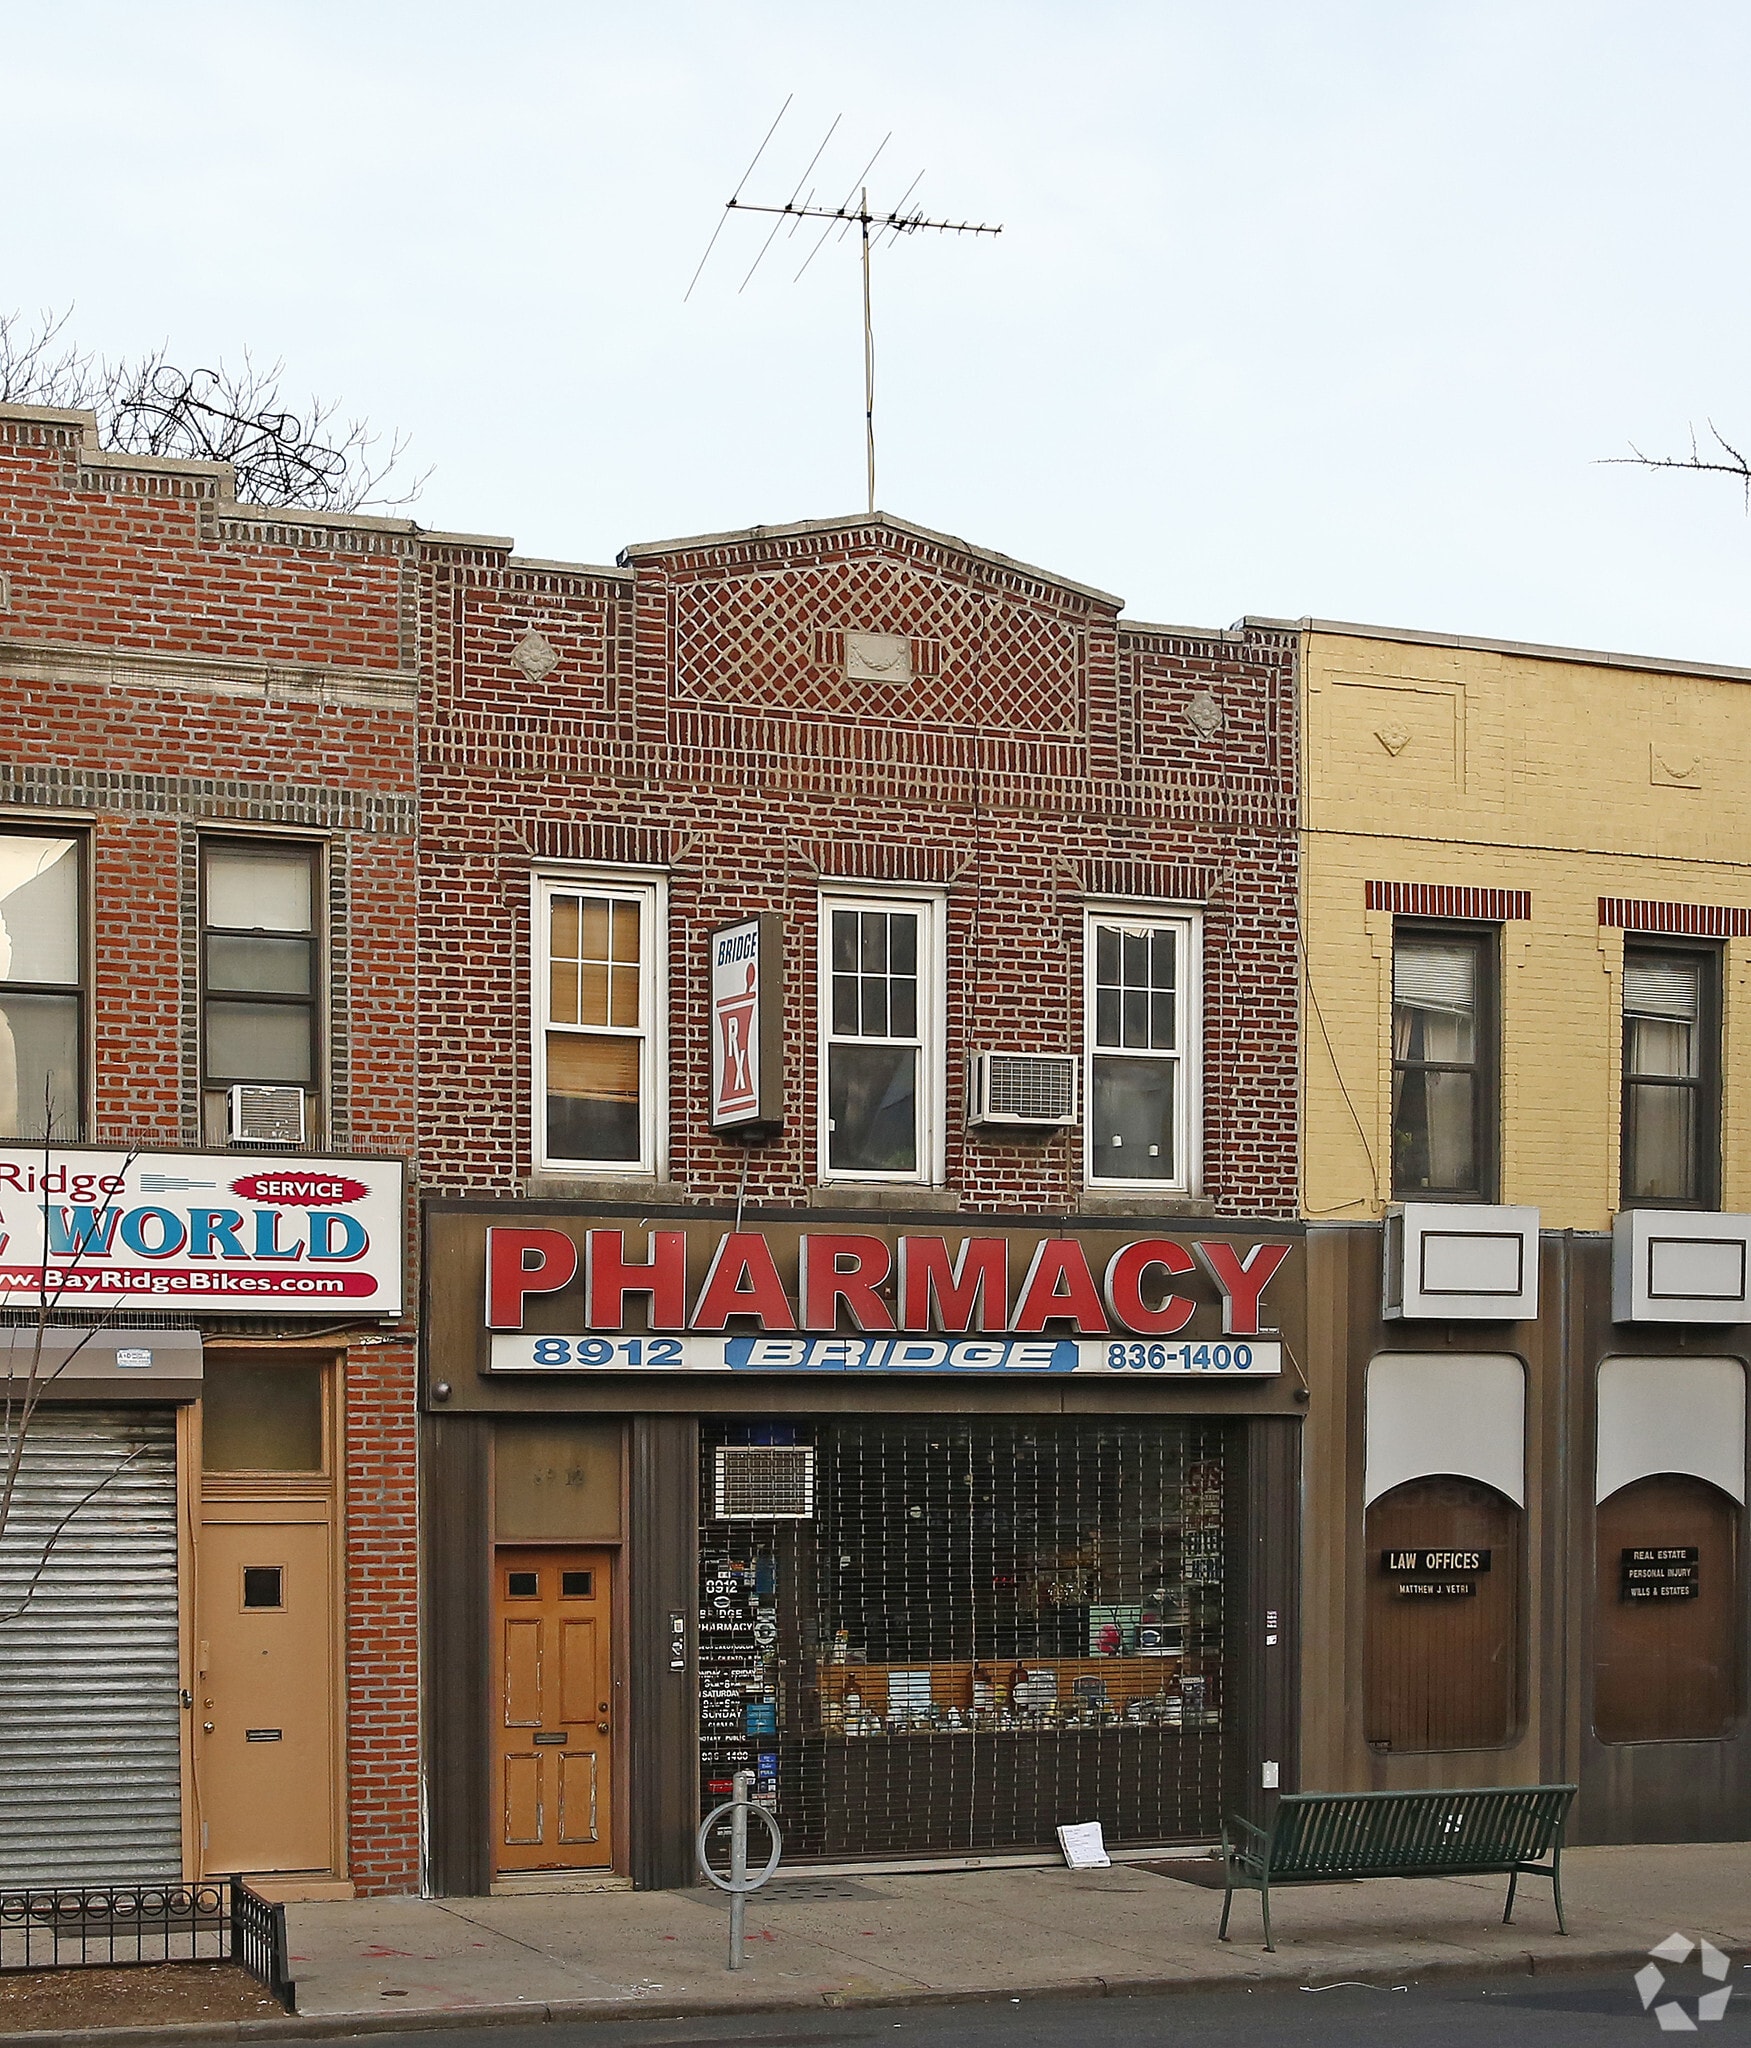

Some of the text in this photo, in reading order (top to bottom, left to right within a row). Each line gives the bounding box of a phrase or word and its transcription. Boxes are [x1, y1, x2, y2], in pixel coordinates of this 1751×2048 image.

[718, 931, 757, 967] BRIDGE
[0, 1163, 126, 1203] Ridge
[255, 1180, 344, 1199] SERVICE
[38, 1204, 371, 1262] WORLD
[485, 1226, 1293, 1335] PHARMACY
[532, 1338, 684, 1367] 8912
[746, 1338, 1059, 1369] BRIDGE
[1107, 1343, 1253, 1370] 836-1400
[1390, 1552, 1479, 1569] LAW OFFICES
[1633, 1550, 1687, 1560] REAL ESTATE
[1629, 1568, 1692, 1578] PERSONAL INJURY
[1399, 1584, 1434, 1594] MATTHEW
[1630, 1587, 1651, 1596] WILLS
[1660, 1586, 1690, 1596] ESTATES
